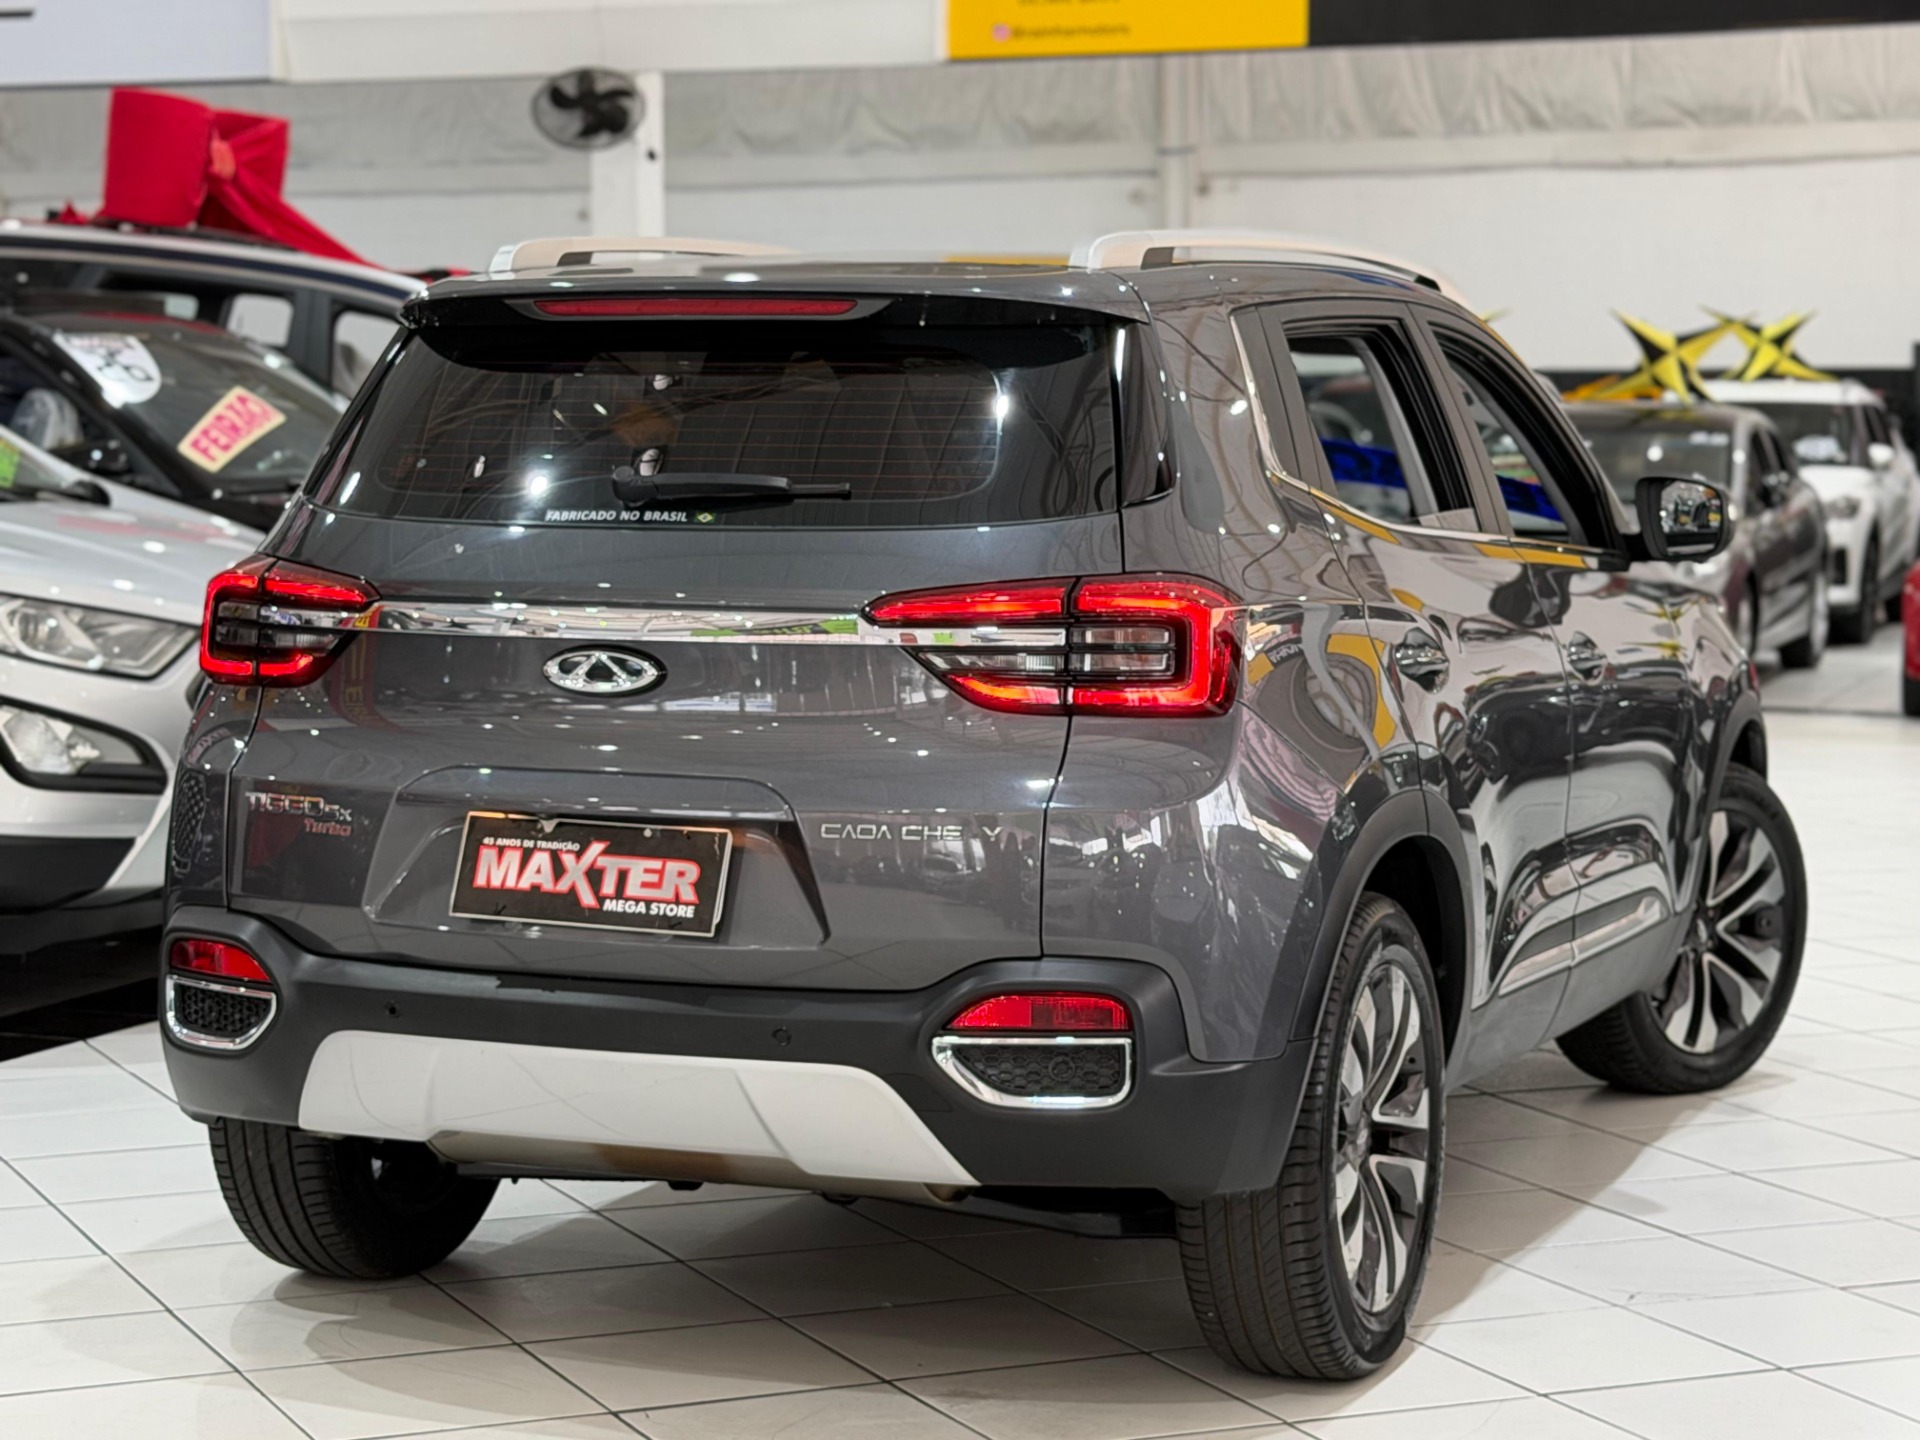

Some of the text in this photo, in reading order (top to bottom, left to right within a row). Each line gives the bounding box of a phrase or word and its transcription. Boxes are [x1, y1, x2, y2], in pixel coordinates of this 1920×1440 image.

[544, 509, 688, 523] FABRICADO NO BRASIL
[820, 823, 1004, 842] CAOA CHEY
[495, 837, 522, 848] ANOS
[522, 839, 535, 849] DE
[536, 840, 581, 852] TRADIÇÃO
[472, 839, 701, 910] MAXTER
[602, 898, 696, 918] MEGA STORE
